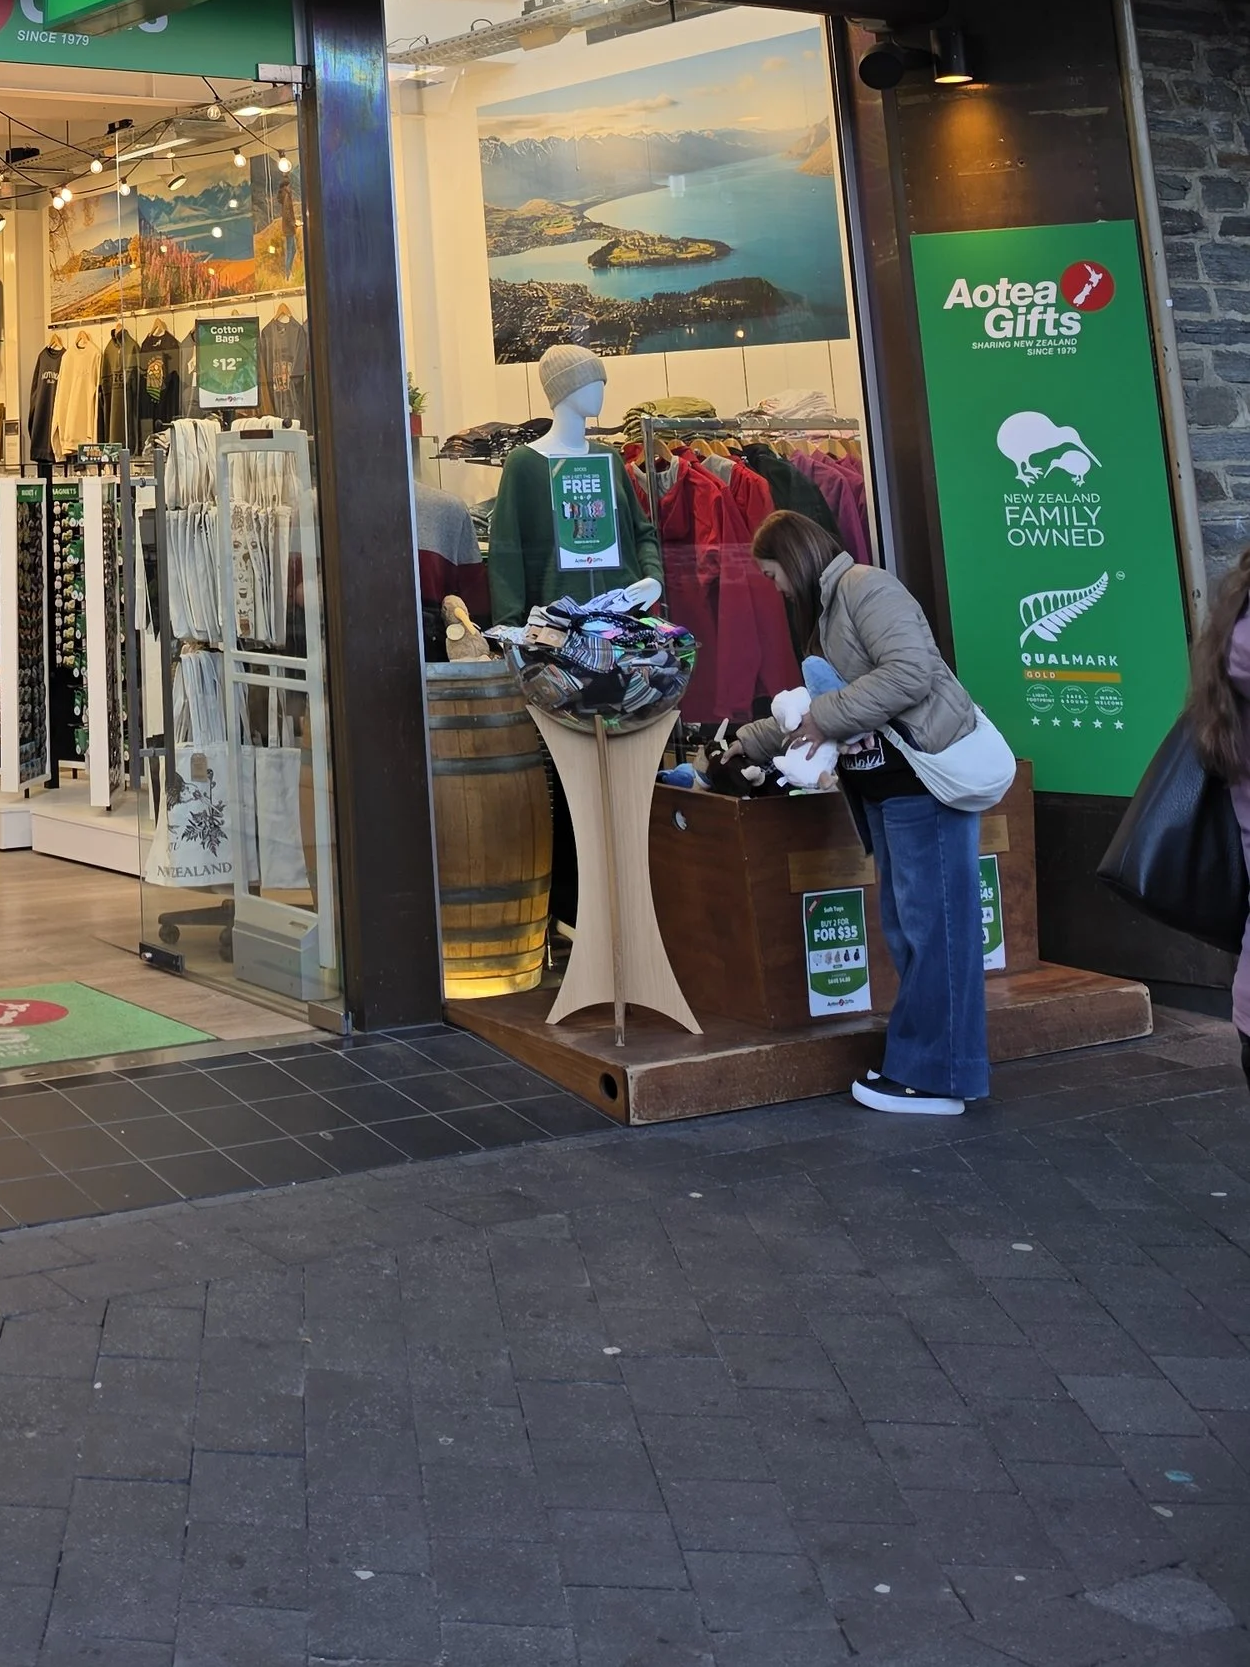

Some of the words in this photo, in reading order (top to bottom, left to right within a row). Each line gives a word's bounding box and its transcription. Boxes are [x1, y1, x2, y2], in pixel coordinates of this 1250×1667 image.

[17, 29, 57, 44] SINCE
[61, 33, 90, 47] 1979
[942, 277, 1057, 310] Aotea
[984, 305, 1082, 339] Gifts
[210, 325, 244, 335] Cotton
[215, 335, 240, 344] Bags
[971, 340, 1012, 350] SHARING
[1013, 339, 1034, 348] NEW
[1036, 337, 1078, 347] ZEALAND
[1027, 348, 1054, 356] SINCE
[1057, 347, 1077, 355] 1979
[562, 478, 602, 494] FREE
[1003, 493, 1034, 504] NEW
[1038, 493, 1101, 504] ZEALAND
[1005, 505, 1102, 526] FAMILY
[1007, 528, 1105, 547] OWNED
[1021, 652, 1119, 667] QUALMARK
[1026, 671, 1056, 679] GOLD
[820, 919, 832, 928] BUY
[833, 919, 837, 927] 2
[837, 917, 850, 926] FOR
[813, 928, 837, 943] FOR
[837, 924, 859, 941] $35
